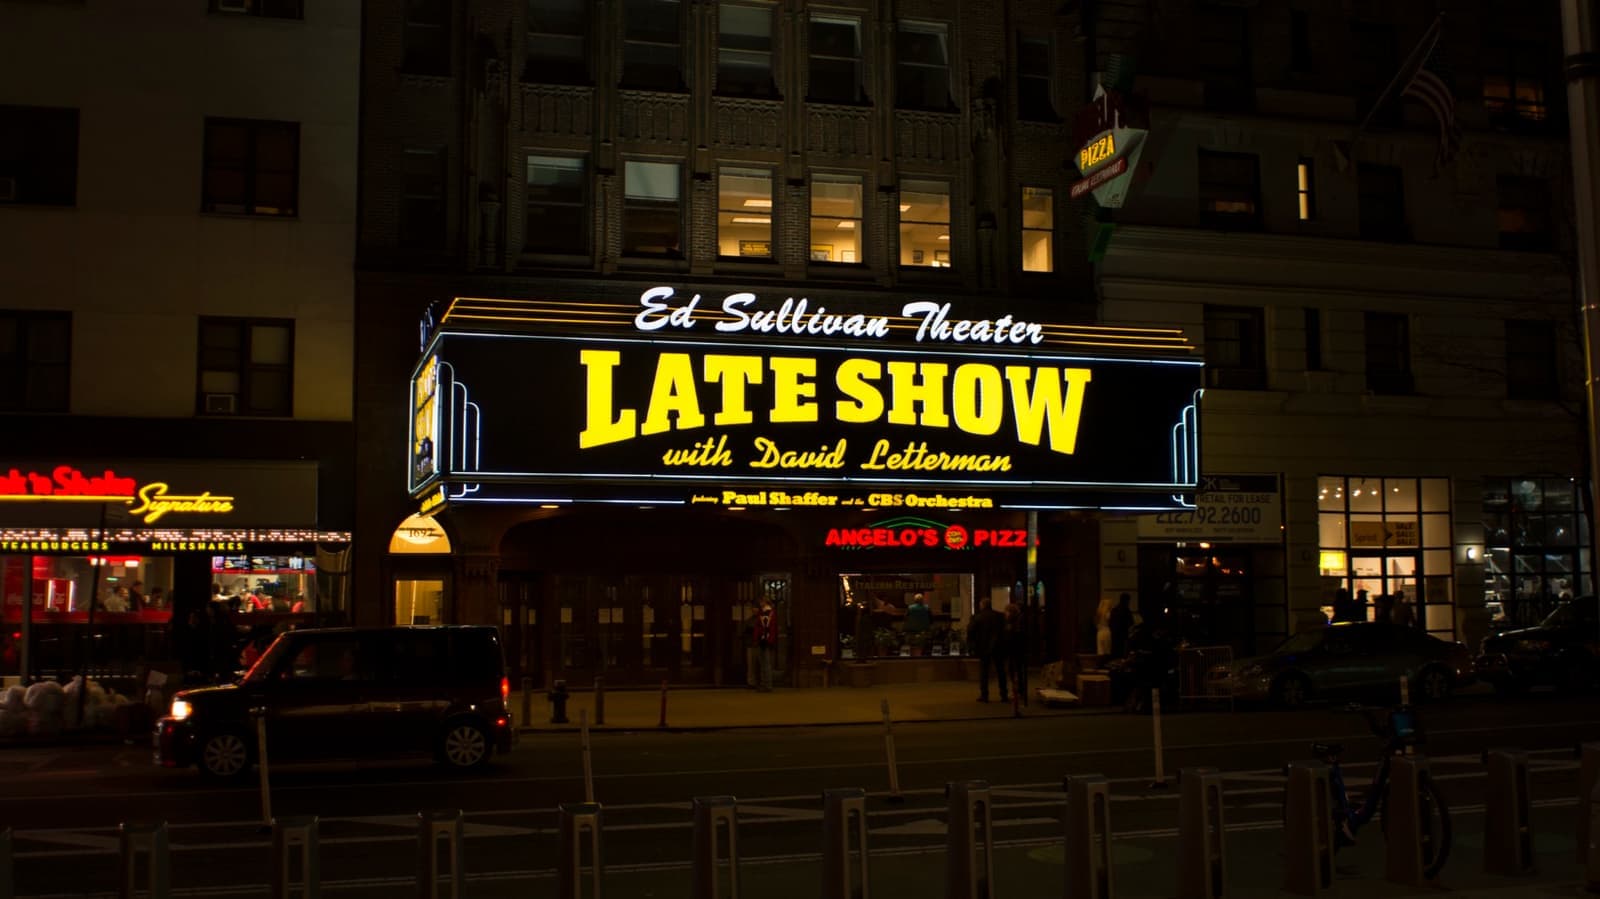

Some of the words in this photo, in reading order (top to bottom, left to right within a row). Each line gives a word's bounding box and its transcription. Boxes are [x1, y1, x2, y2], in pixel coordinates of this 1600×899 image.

[1080, 133, 1115, 170] PIZZA
[634, 286, 701, 331] Ed
[714, 292, 890, 338] Sullivan
[901, 301, 1045, 345] Theater
[579, 349, 820, 450] LATE
[835, 358, 1093, 456] SHOW
[662, 434, 733, 468] with
[749, 436, 847, 470] David
[860, 438, 1013, 473] Letterman
[52, 465, 137, 496] Shake
[129, 482, 234, 524] Signature
[721, 490, 767, 505] Paul
[768, 491, 839, 506] Shaffer
[867, 493, 904, 507] CBS
[904, 494, 994, 508] Orchestra
[1155, 506, 1262, 525] 212.792.2600
[151, 542, 244, 551] MILKSHAKES
[825, 527, 939, 546] ANGELO'S
[973, 529, 1040, 547] PIZZ
